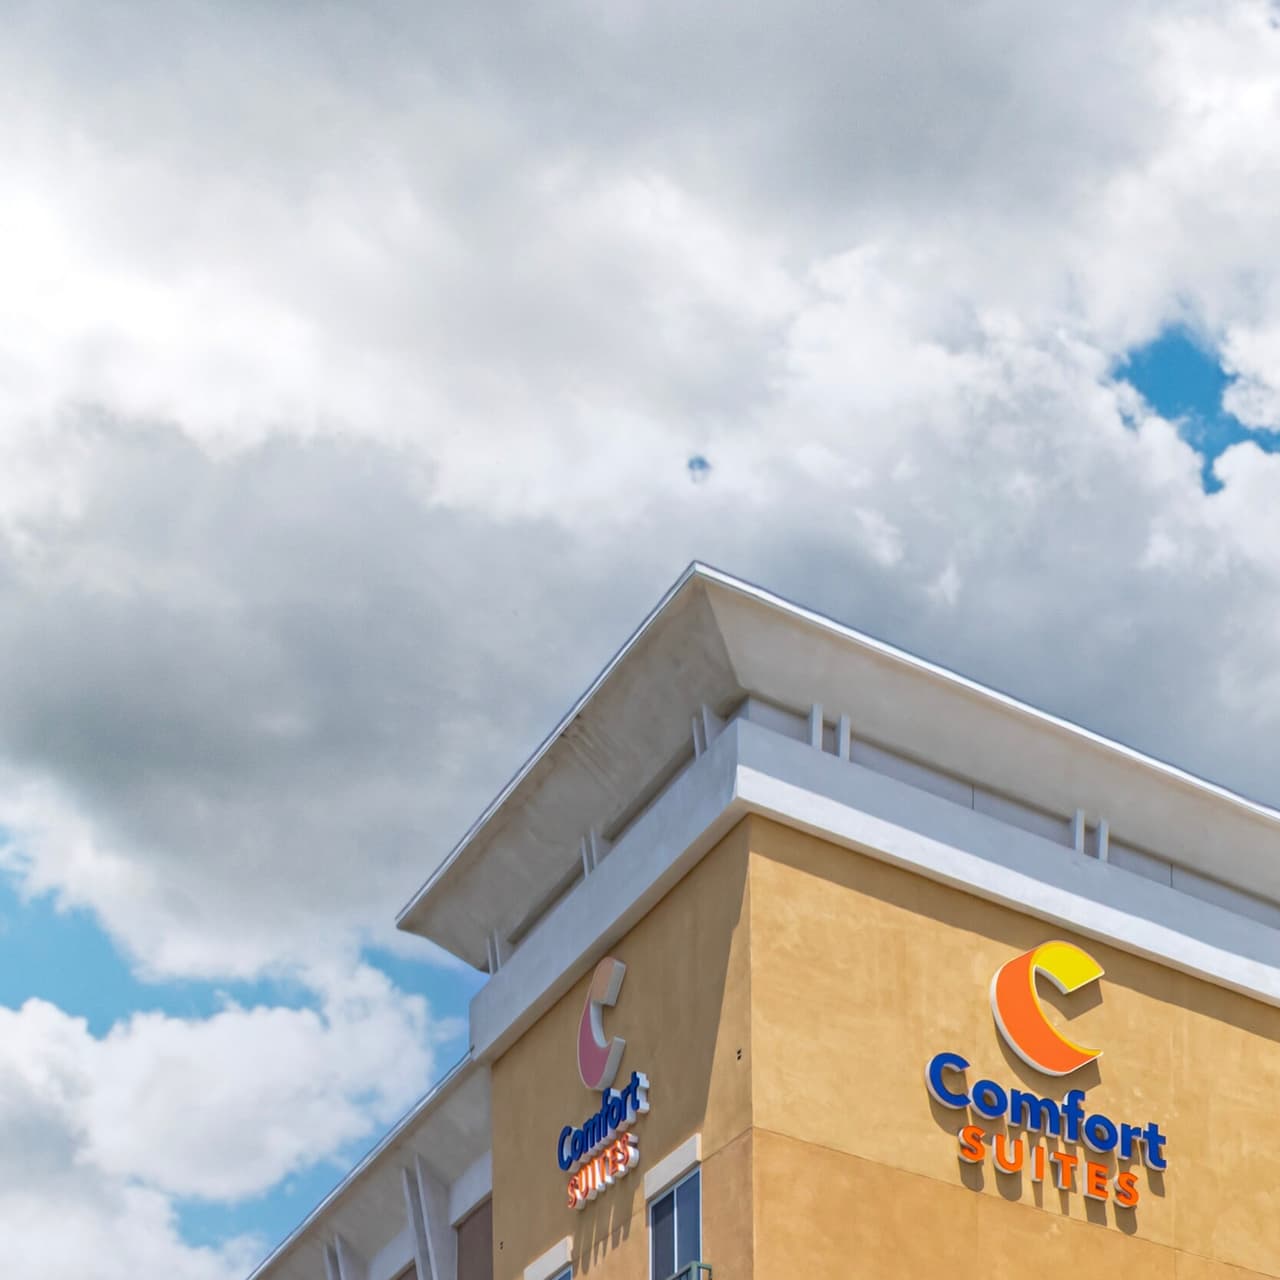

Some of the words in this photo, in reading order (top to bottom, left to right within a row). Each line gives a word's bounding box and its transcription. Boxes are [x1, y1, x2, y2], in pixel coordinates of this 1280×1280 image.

[557, 1070, 649, 1172] Comfort
[925, 1051, 1167, 1171] Comfort
[567, 1132, 639, 1210] SUITES
[958, 1125, 1139, 1208] SUITES
